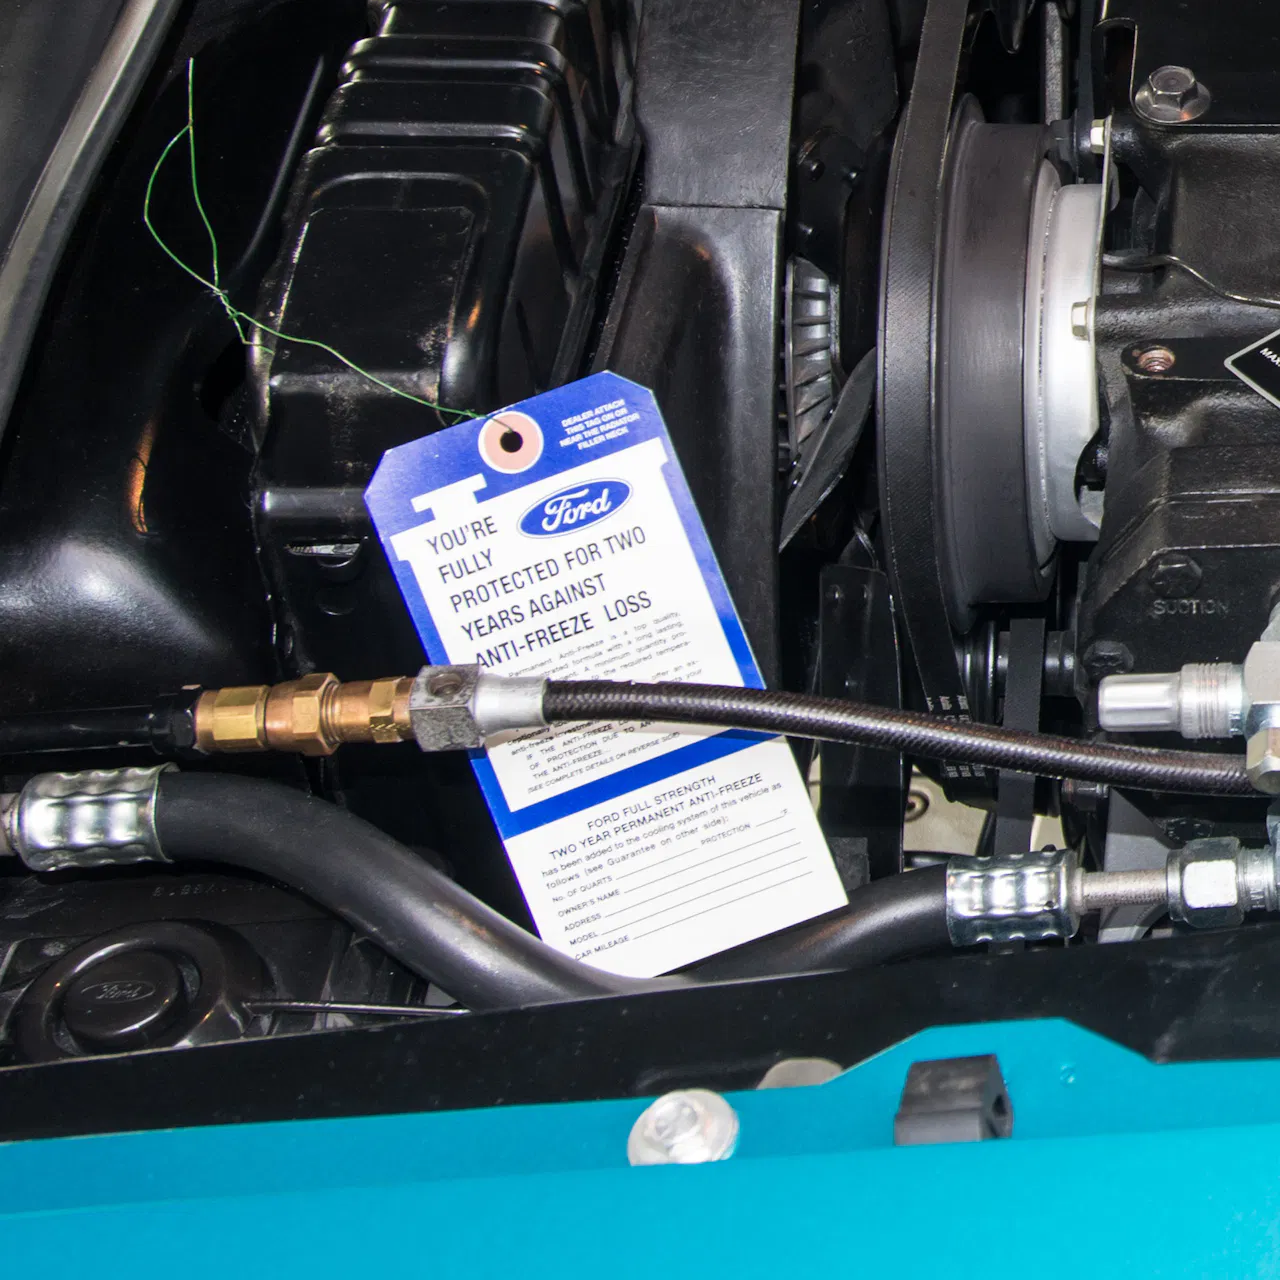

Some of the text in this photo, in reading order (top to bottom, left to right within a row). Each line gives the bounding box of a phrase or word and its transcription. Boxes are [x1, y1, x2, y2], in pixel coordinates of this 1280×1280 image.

[426, 515, 498, 555] YOU'RE
[541, 488, 612, 532] Ford
[438, 548, 493, 584] FULLY
[449, 526, 646, 614] PROTECTED FOR TWO
[460, 572, 605, 641] YEARS AGAINST
[477, 590, 652, 668] ANTI-FREEZE LOSS
[541, 782, 782, 878] has been added to the cooling system of this vehicle as
[548, 772, 763, 860] TWO YEAR PERMANENT ANTI-FREEZE
[587, 775, 716, 831] FORD FULL STRENGTH
[546, 873, 580, 890] follows
[584, 863, 604, 877] (see
[606, 843, 656, 867] Guarantee
[659, 837, 673, 847] on
[675, 826, 699, 841] other
